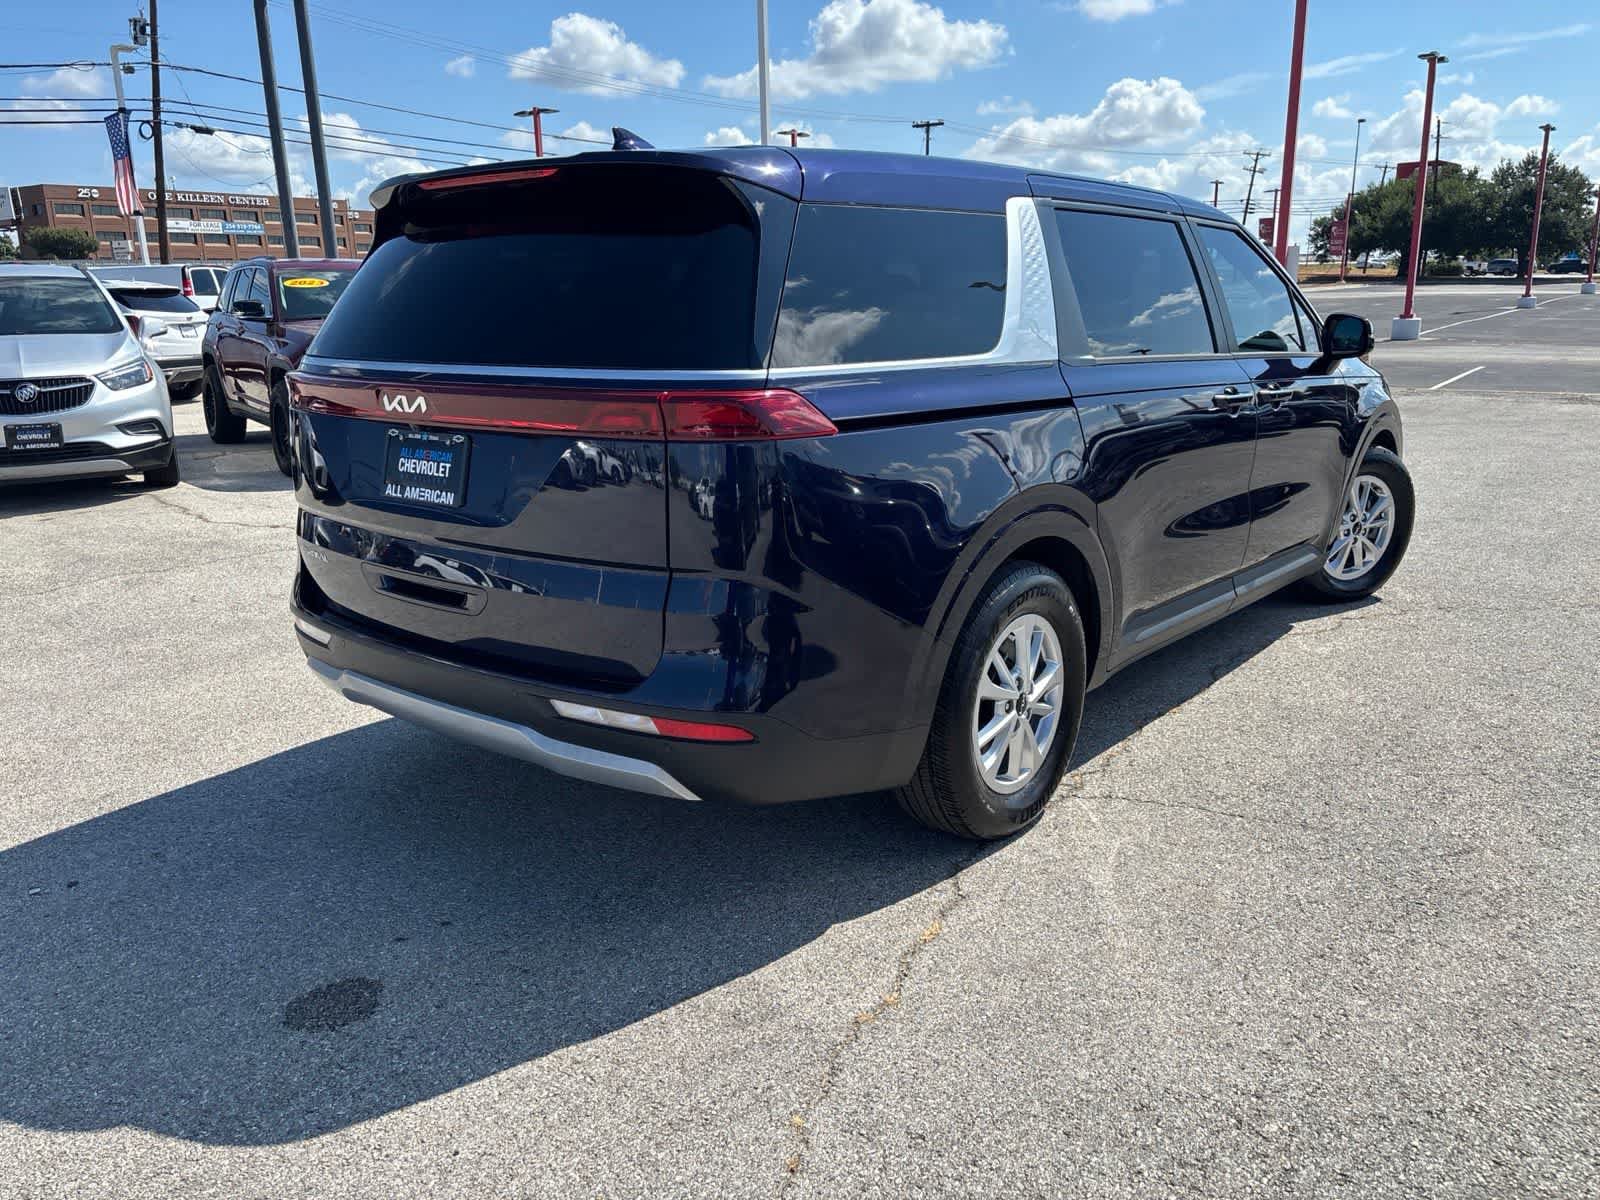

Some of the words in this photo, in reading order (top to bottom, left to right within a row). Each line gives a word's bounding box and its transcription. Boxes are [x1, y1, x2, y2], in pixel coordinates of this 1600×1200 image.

[148, 191, 173, 201] OE
[176, 193, 224, 204] KILLEEN
[229, 195, 270, 206] CENTER
[383, 394, 427, 413] KIA
[16, 433, 51, 441] CHEVROLET
[400, 447, 412, 458] ALL
[415, 448, 452, 462] AMERICAN
[398, 458, 451, 477] CHEVROLET
[385, 483, 402, 498] ALL
[404, 486, 454, 505] AMERICAN
